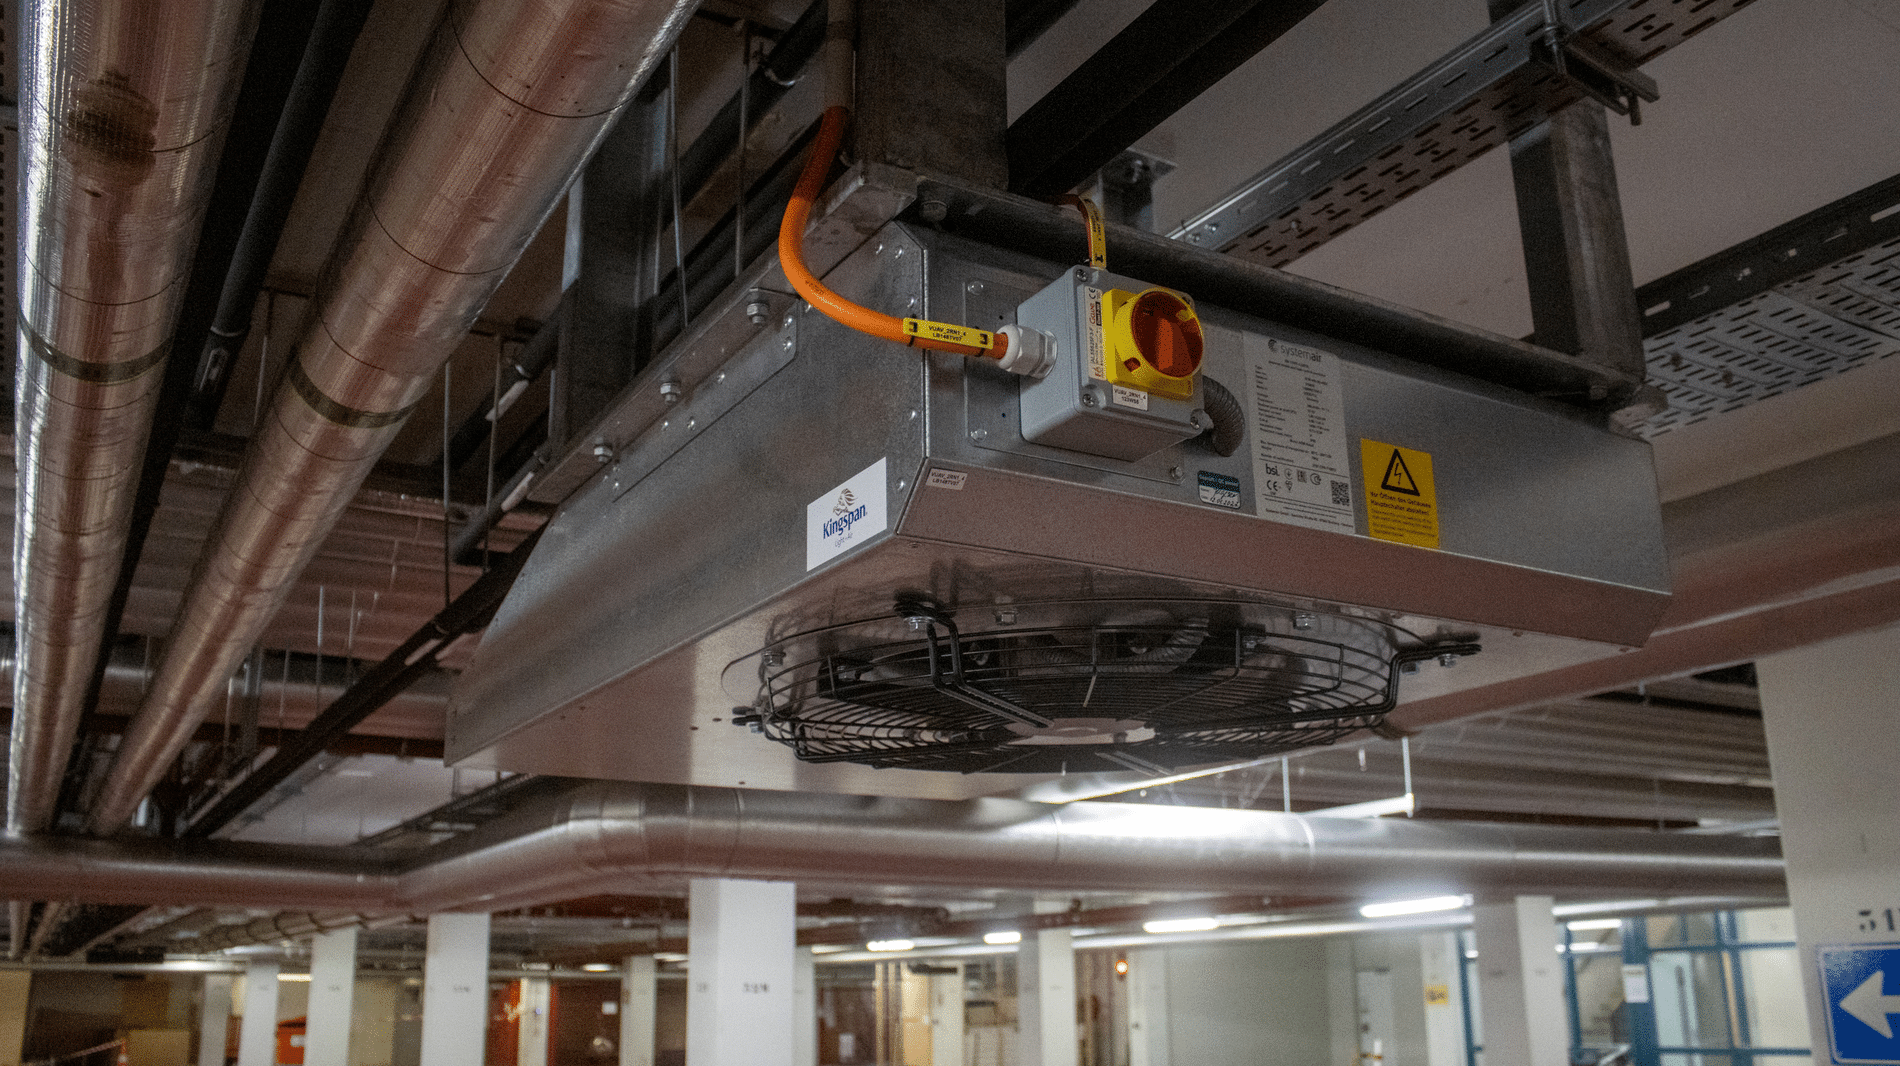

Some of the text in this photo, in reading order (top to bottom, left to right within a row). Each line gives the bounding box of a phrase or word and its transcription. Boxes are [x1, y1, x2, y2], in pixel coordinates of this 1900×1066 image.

[1280, 344, 1322, 362] systemair
[823, 504, 866, 539] Kingspan
[1858, 908, 1900, 931] 51
